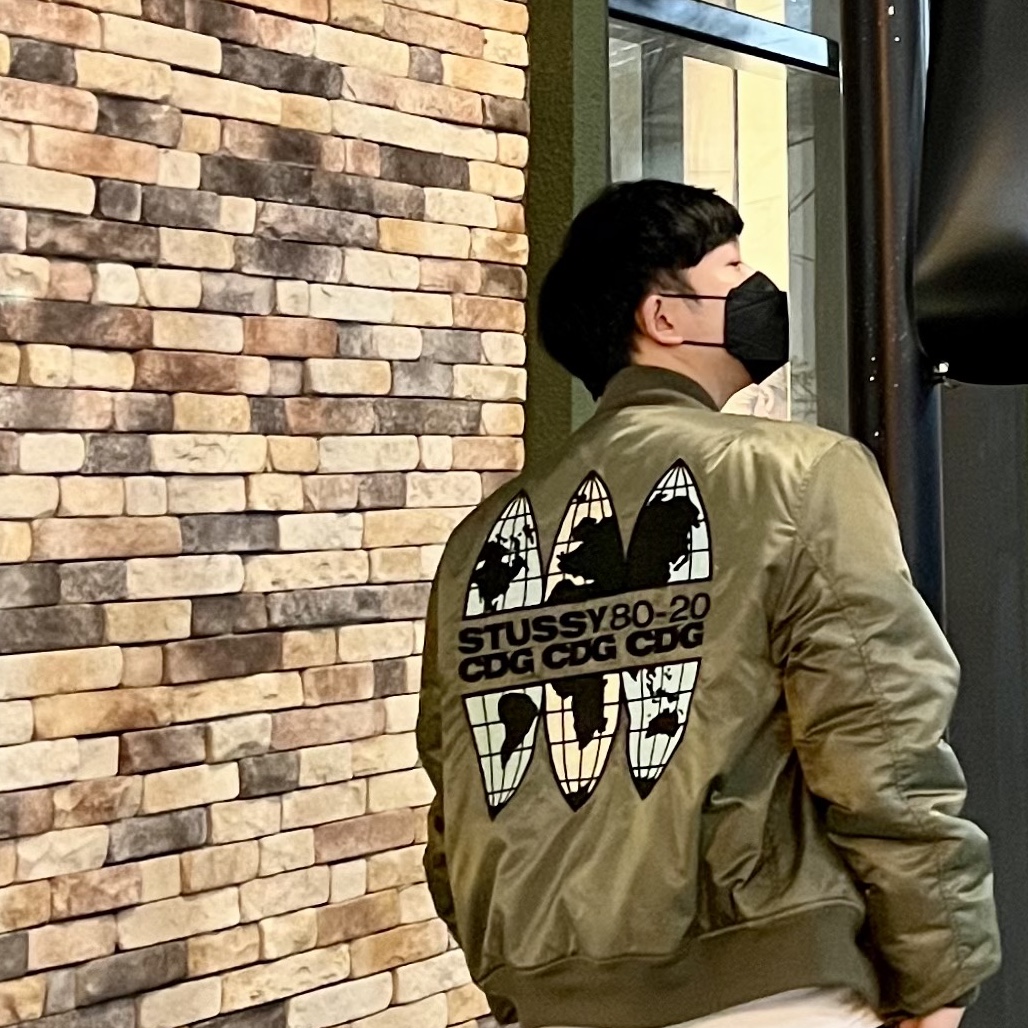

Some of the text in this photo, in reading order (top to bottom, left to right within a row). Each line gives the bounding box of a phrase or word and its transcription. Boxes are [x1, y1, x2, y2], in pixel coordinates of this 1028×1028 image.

[457, 592, 711, 655] STUSSY 80-20
[457, 620, 704, 683] CDG CDG CDG
